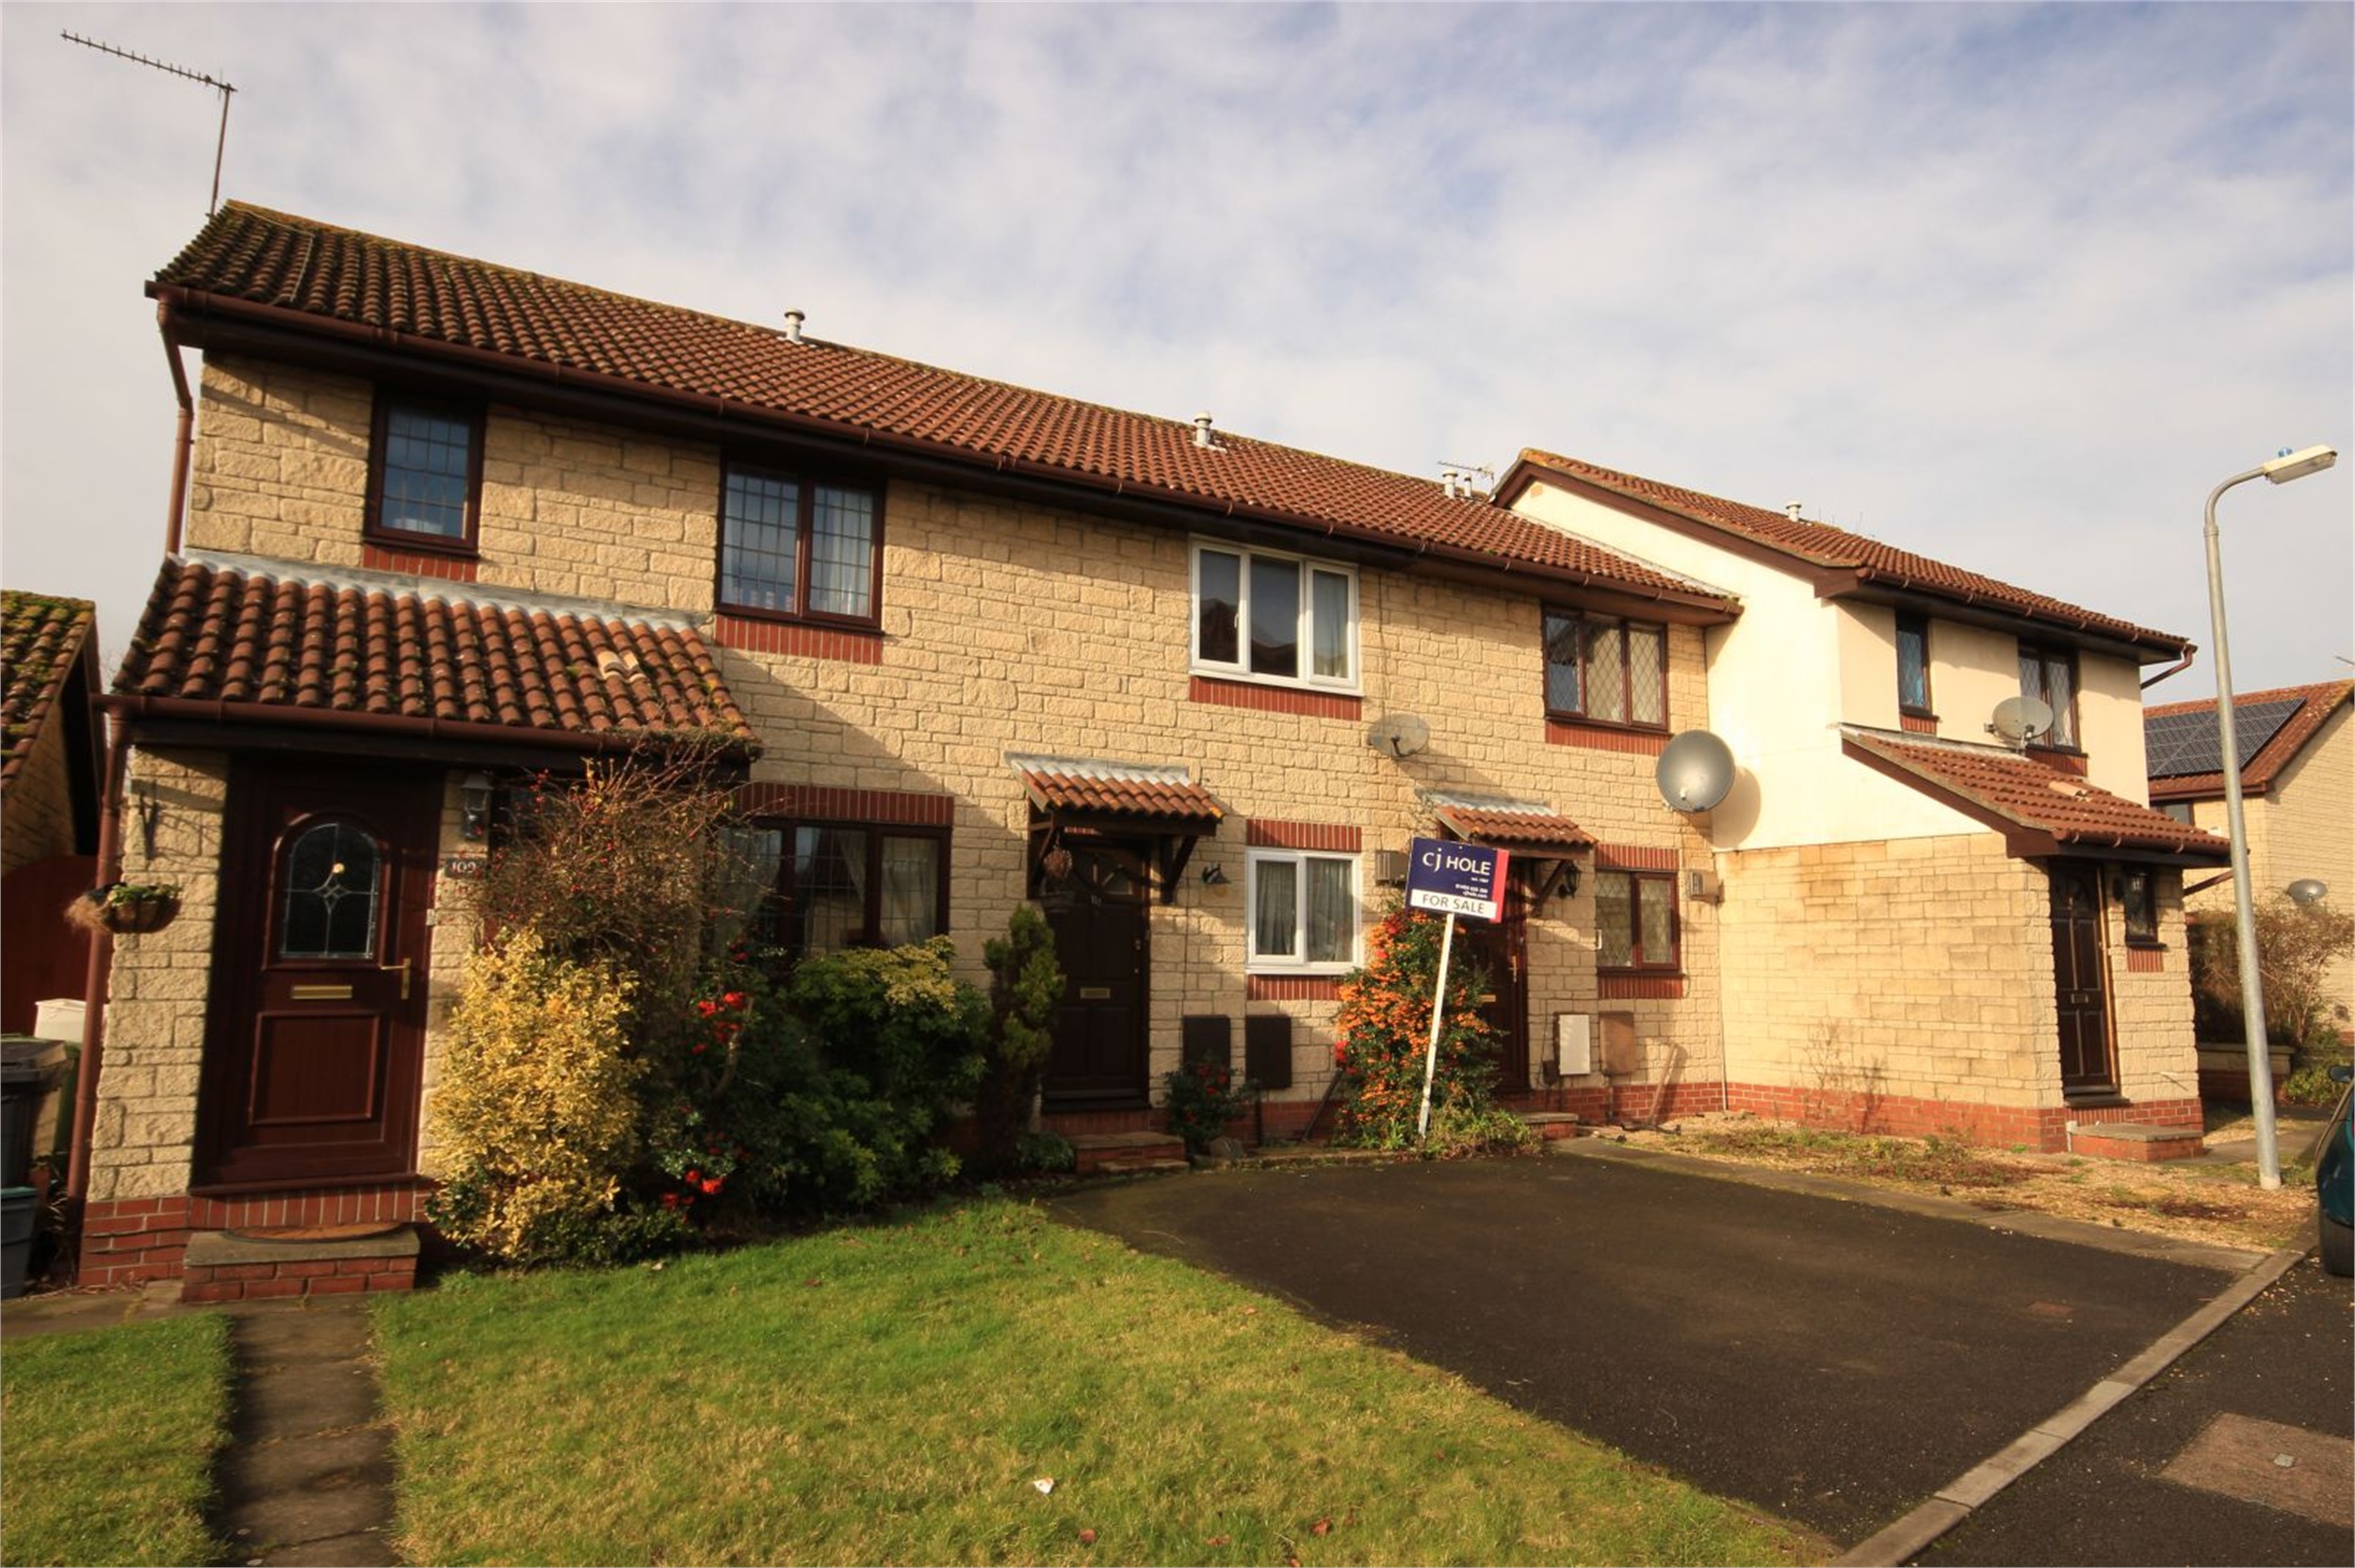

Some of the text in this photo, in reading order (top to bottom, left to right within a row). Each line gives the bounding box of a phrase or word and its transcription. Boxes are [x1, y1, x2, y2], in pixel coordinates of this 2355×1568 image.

[452, 861, 477, 873] 109
[1446, 855, 1491, 876] HOLE
[1422, 894, 1448, 908] FOR
[1453, 898, 1485, 913] SALE
